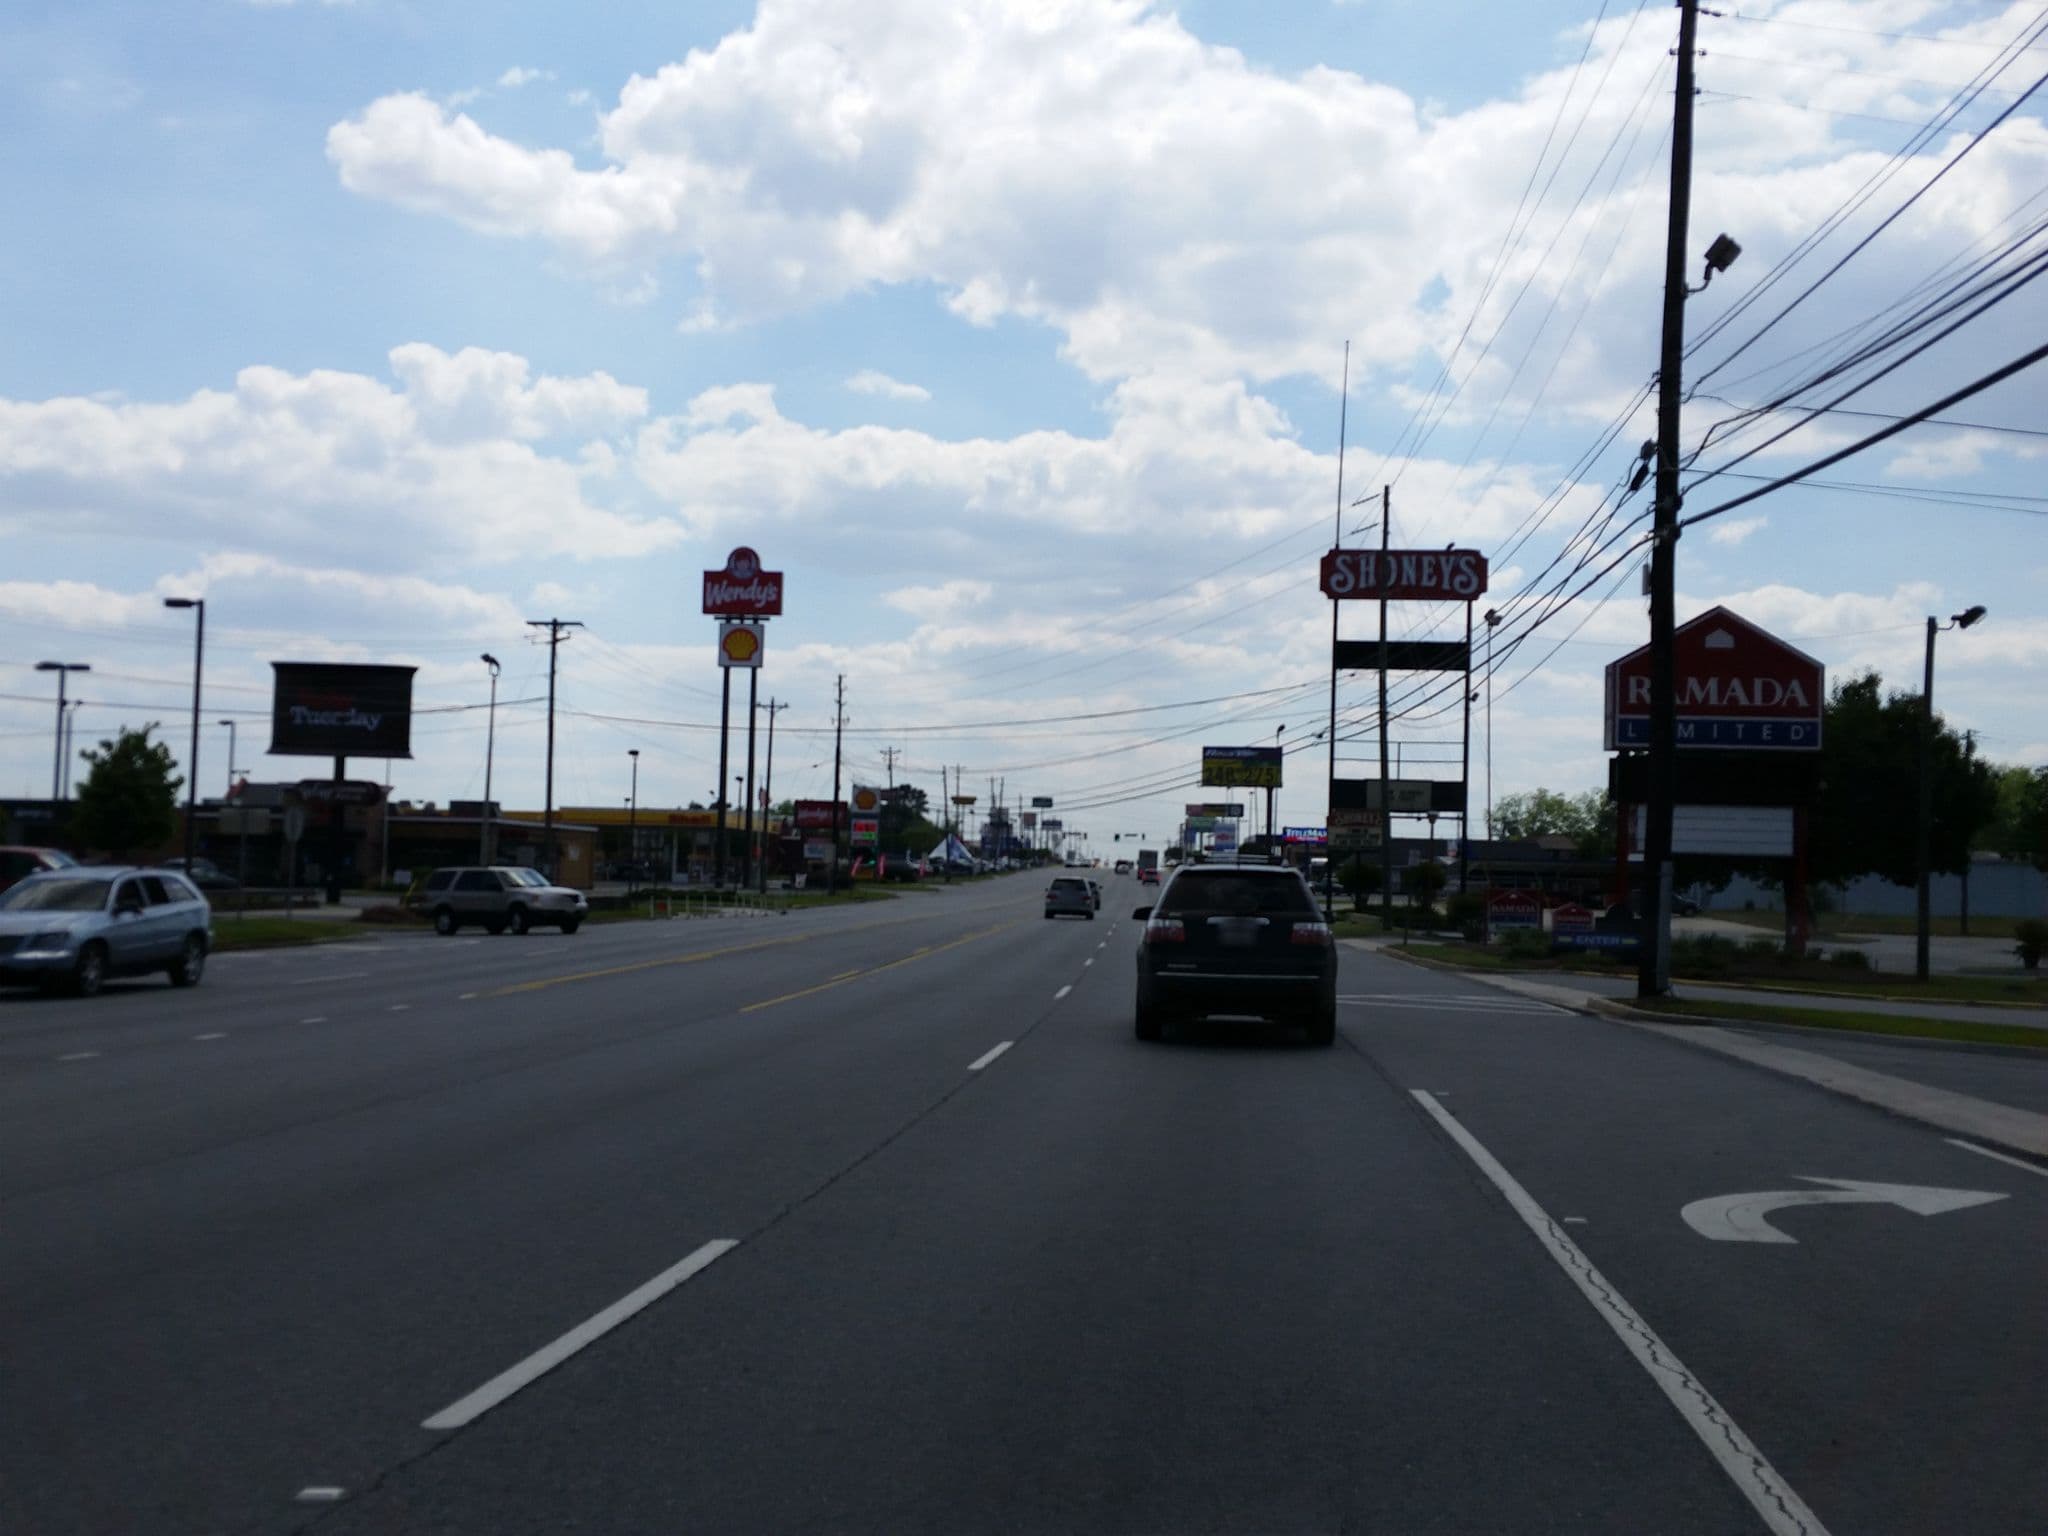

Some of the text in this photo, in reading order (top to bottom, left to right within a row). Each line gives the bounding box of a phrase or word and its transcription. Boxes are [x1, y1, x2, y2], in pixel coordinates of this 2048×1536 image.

[705, 578, 777, 608] Wendy's
[1627, 675, 1809, 707] RMADA
[1626, 720, 1806, 741] LMITED
